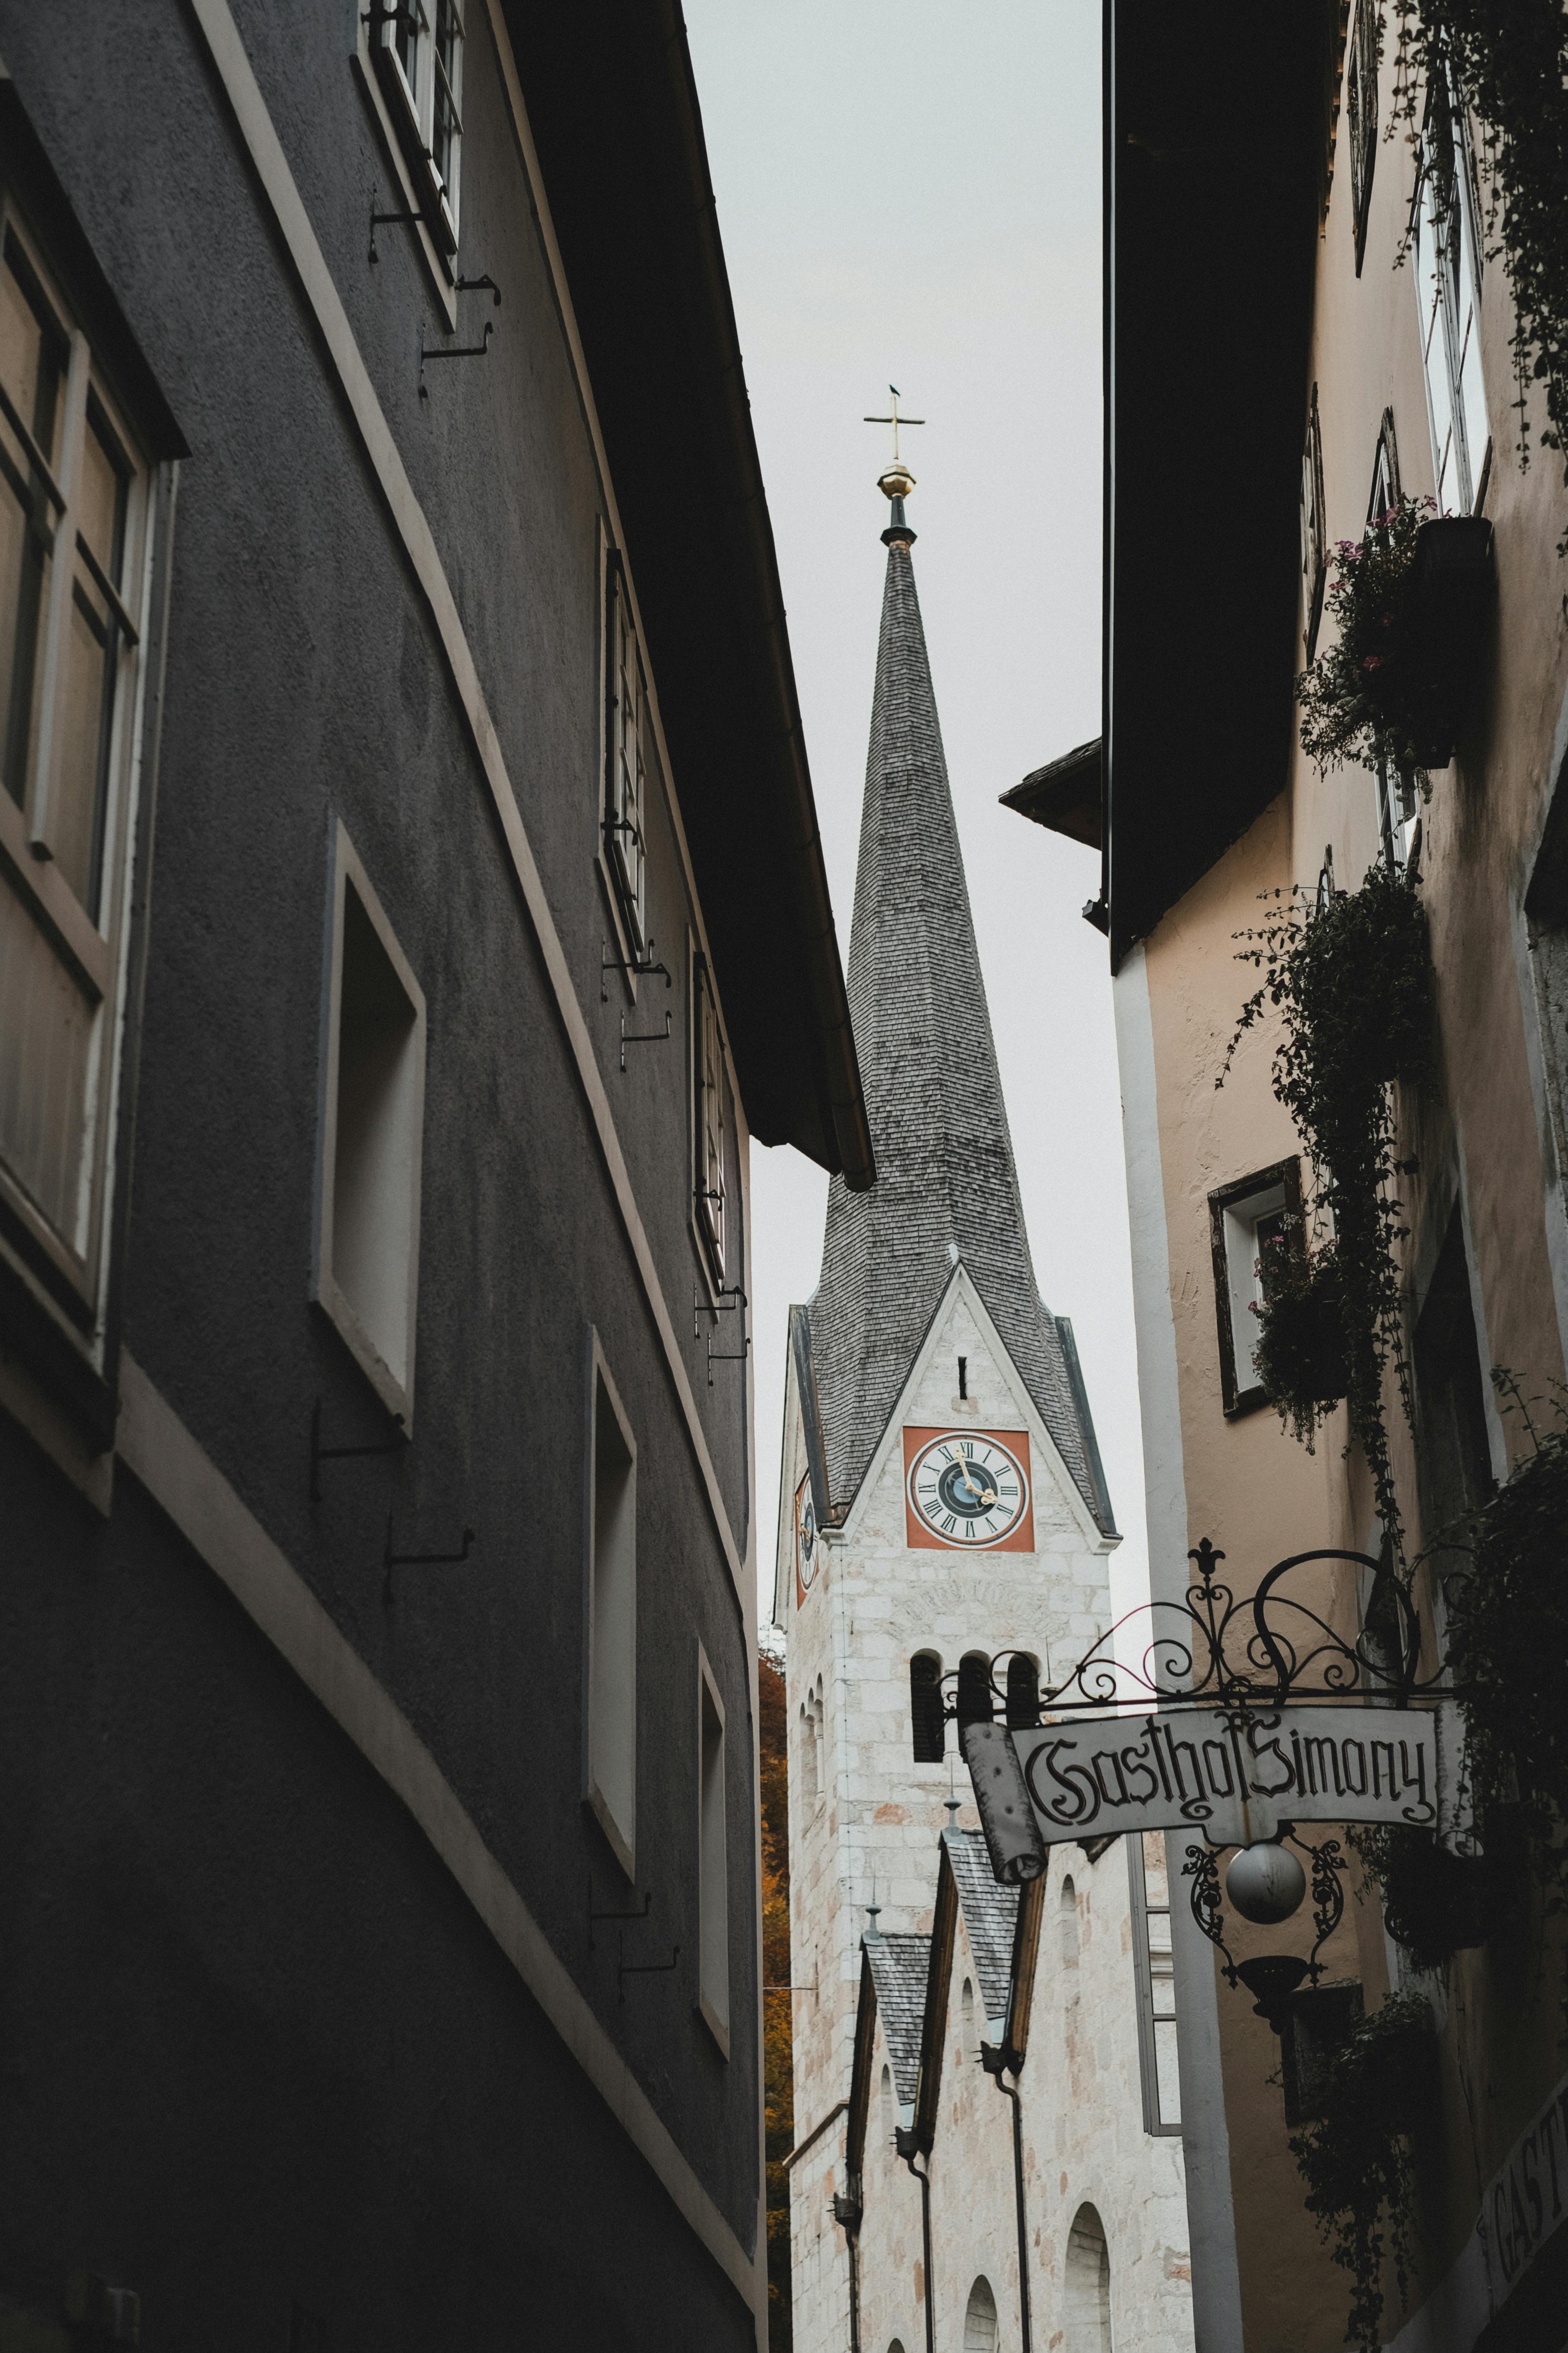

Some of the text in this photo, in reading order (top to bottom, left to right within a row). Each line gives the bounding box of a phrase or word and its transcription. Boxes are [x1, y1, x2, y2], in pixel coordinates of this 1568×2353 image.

[937, 1445, 955, 1464] XI
[982, 1449, 993, 1463] I
[923, 1462, 940, 1475] X
[994, 1465, 1011, 1477] II
[918, 1482, 936, 1493] IX
[1000, 1486, 1018, 1496] III
[923, 1498, 944, 1519] VIII
[940, 1514, 958, 1533] VII
[965, 1520, 976, 1538] VI
[985, 1517, 998, 1533] V
[1024, 1711, 1436, 1826] Gasthof Simony
